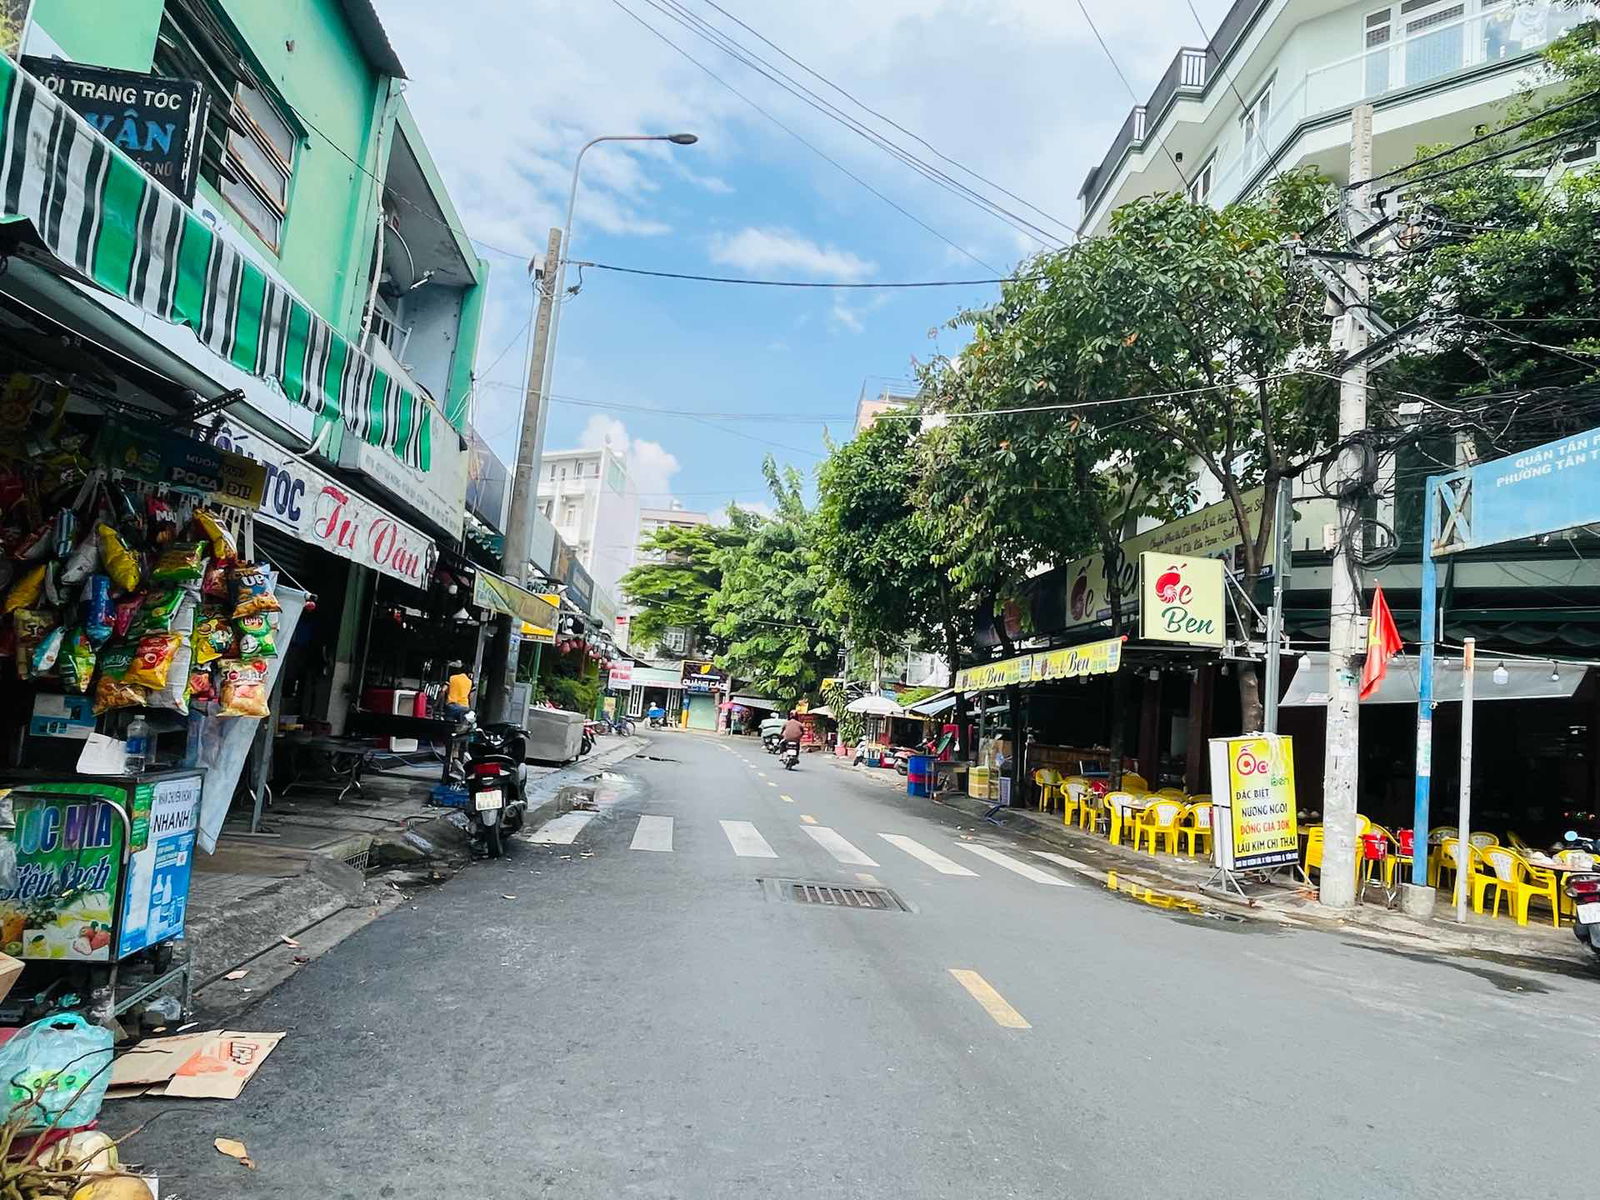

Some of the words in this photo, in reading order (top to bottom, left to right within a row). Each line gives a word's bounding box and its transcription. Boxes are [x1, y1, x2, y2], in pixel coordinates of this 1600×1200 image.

[71, 79, 137, 103] TRANG
[143, 89, 182, 110] TÓC
[1558, 436, 1588, 456] TÂN
[1496, 463, 1552, 488] PHƯỜNG
[1556, 452, 1587, 471] TÂN
[1161, 606, 1215, 635] Ben
[1066, 650, 1090, 675] Ben
[153, 810, 190, 834] NHANH
[1252, 840, 1265, 852] KIM
